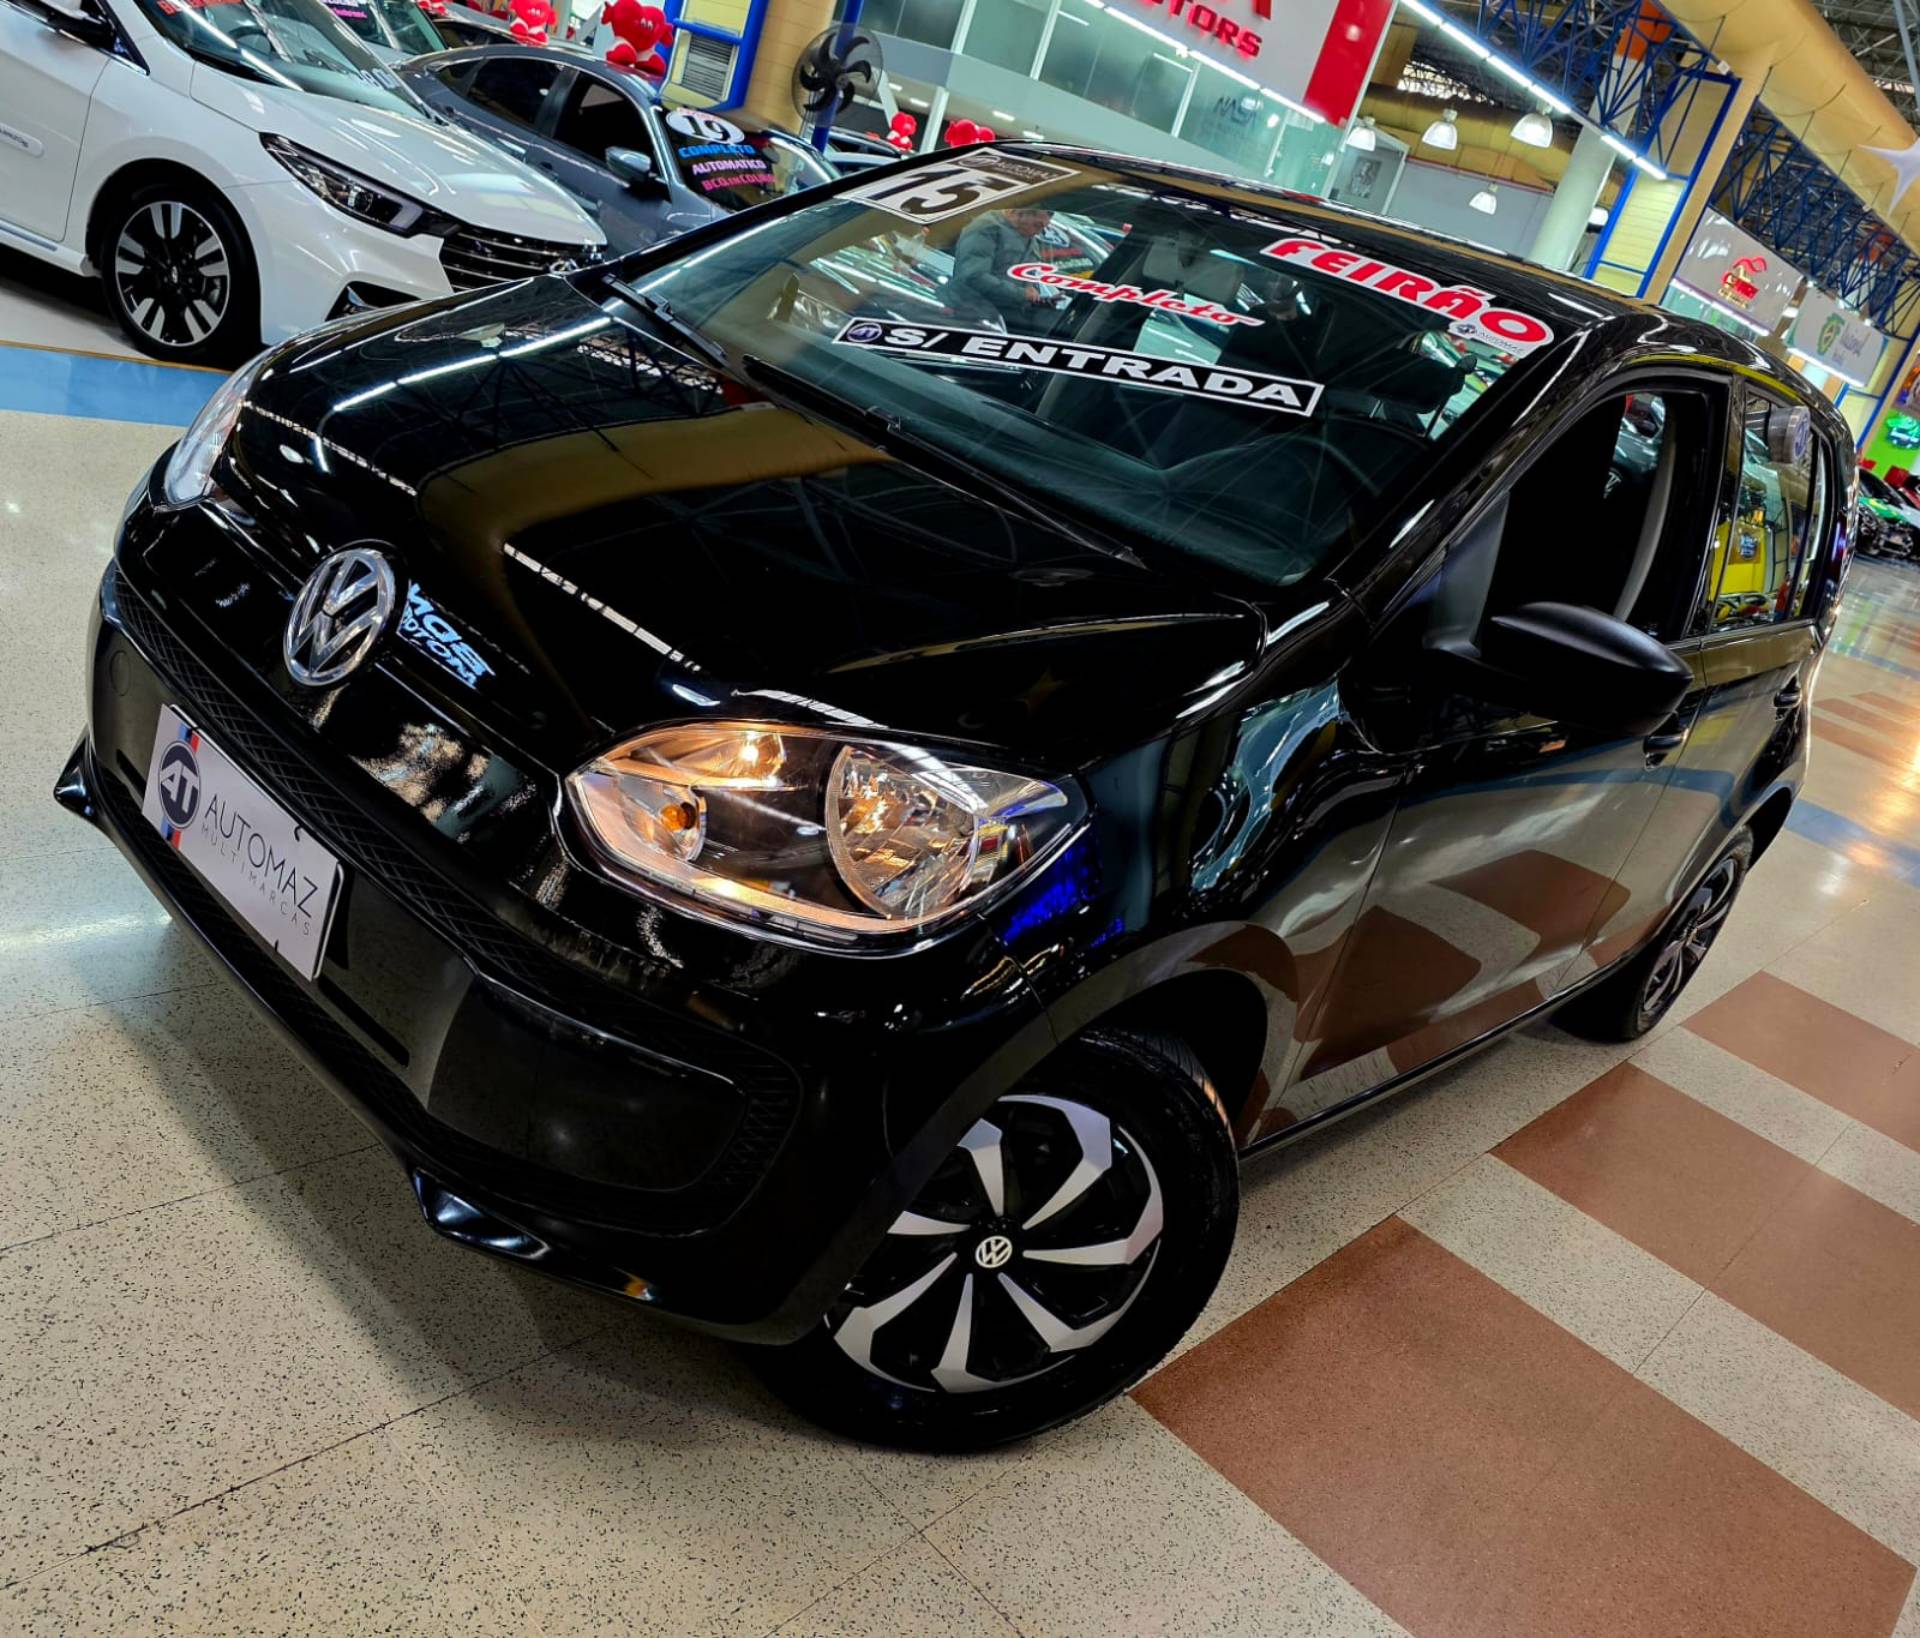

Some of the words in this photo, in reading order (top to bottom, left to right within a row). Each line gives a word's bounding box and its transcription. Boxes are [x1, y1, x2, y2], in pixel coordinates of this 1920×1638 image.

[678, 143, 757, 158] COMPLETO
[683, 115, 731, 140] 19
[867, 168, 1018, 215] 15
[1010, 265, 1264, 326] Completo
[1269, 240, 1547, 342] FEIRÃO
[884, 328, 948, 349] S/
[961, 336, 1303, 408] ENTRADA
[201, 823, 311, 936] MULTIMARCAS
[204, 793, 319, 918] AUTOMAZ
